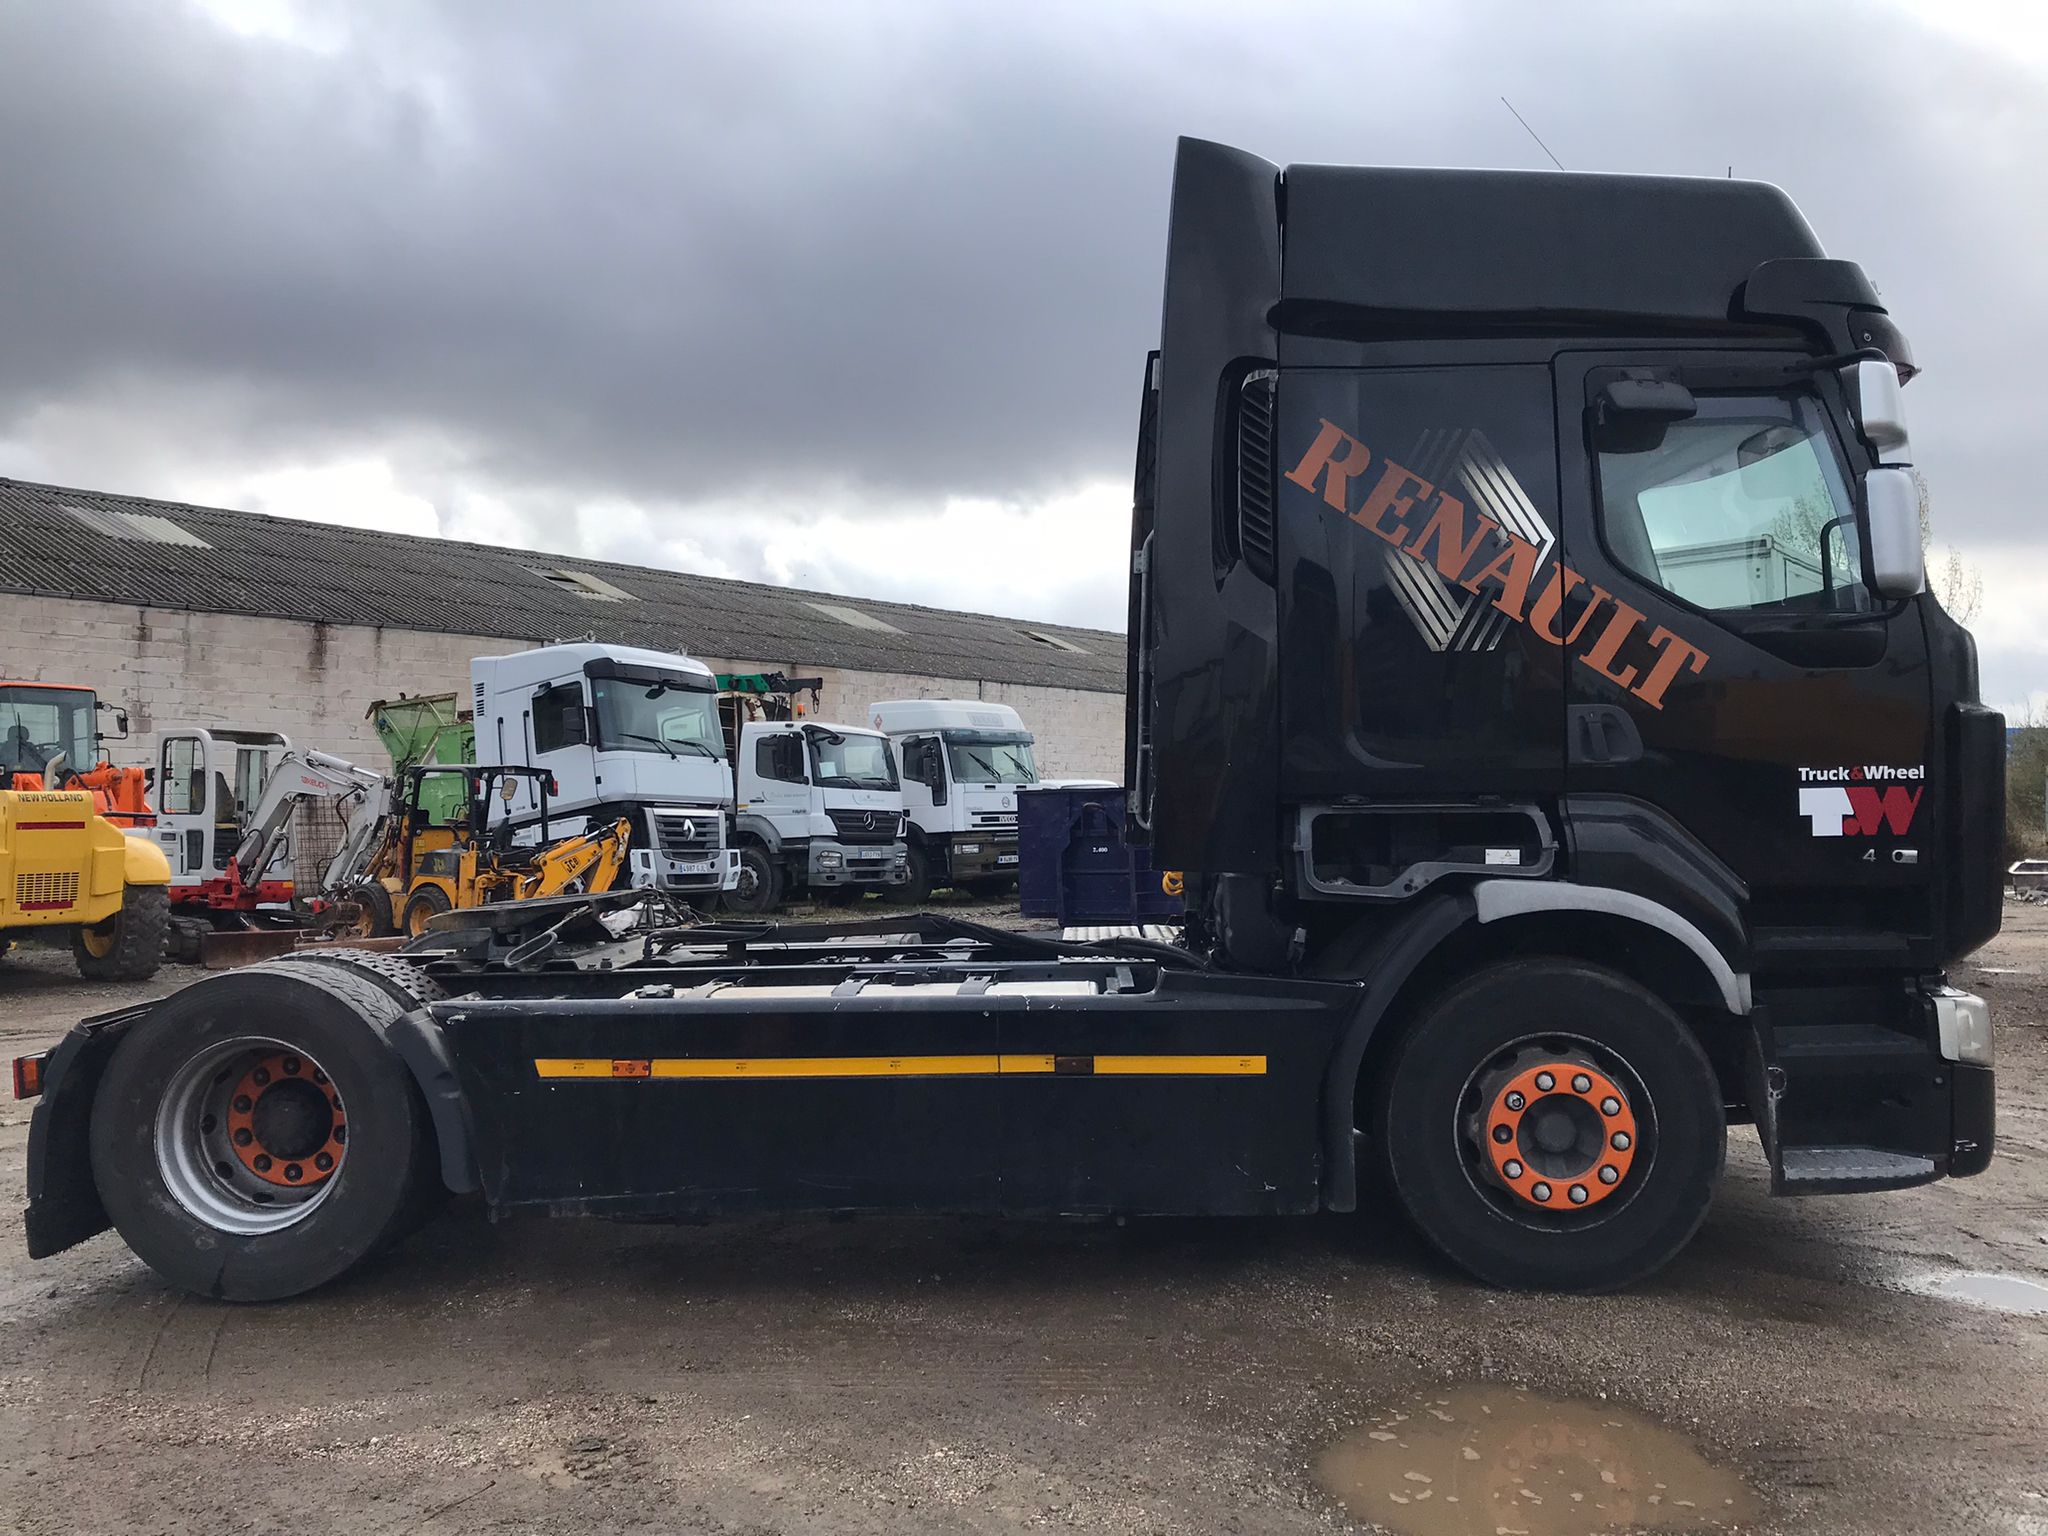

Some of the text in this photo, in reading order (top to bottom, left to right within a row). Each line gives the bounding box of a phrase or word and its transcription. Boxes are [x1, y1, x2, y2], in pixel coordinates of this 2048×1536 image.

[1284, 418, 1709, 711] RENAULT
[1798, 765, 1925, 781] Truck&Wheel
[18, 793, 84, 802] NEW HOLLAND
[564, 857, 579, 873] JCB
